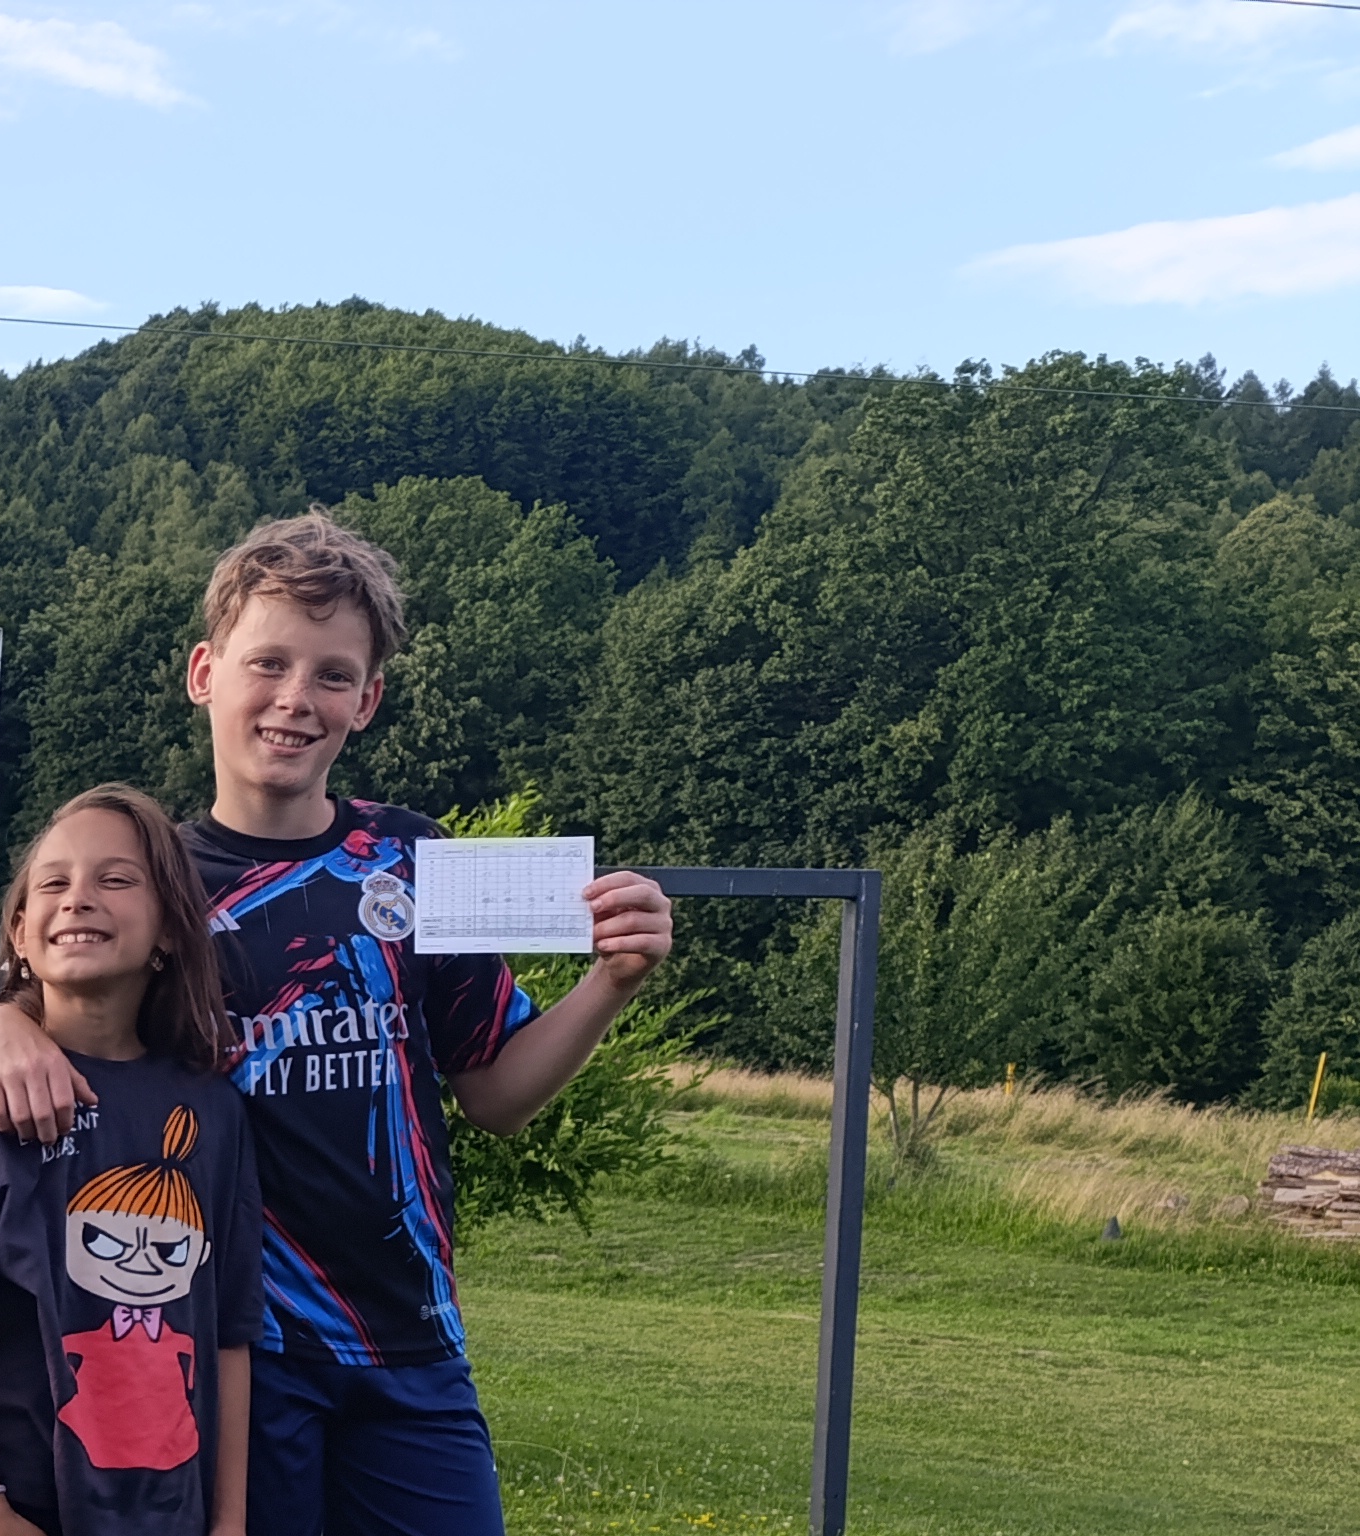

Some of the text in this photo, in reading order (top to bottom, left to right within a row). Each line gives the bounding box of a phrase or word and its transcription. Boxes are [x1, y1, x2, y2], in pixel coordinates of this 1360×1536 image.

[224, 996, 410, 1053] mirates
[249, 1048, 399, 1097] FLY BETTER
